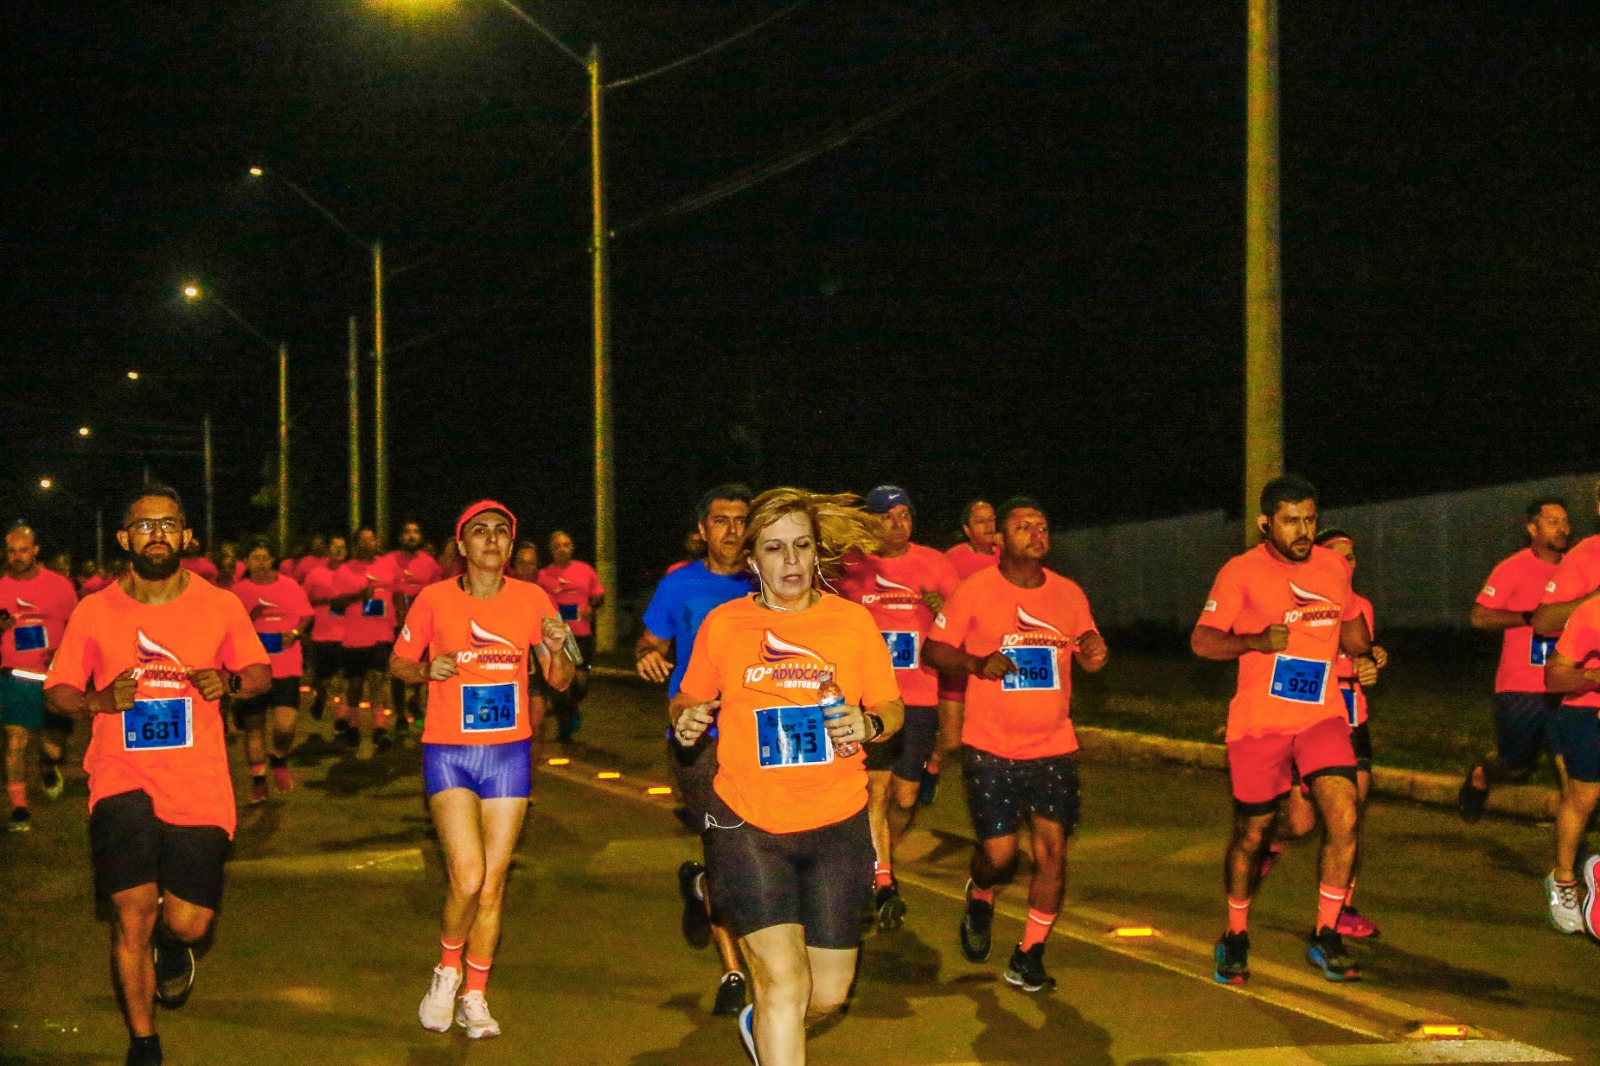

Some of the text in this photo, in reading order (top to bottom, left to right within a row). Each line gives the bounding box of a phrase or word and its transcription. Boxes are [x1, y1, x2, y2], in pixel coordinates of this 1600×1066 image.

[475, 653, 523, 664] ADVOCACIA
[774, 662, 818, 670] CORRIDA
[142, 669, 188, 682] ADVOCACI
[745, 666, 773, 683] 10ª
[1288, 677, 1319, 695] 920
[478, 704, 511, 723] 614
[142, 721, 179, 740] 681
